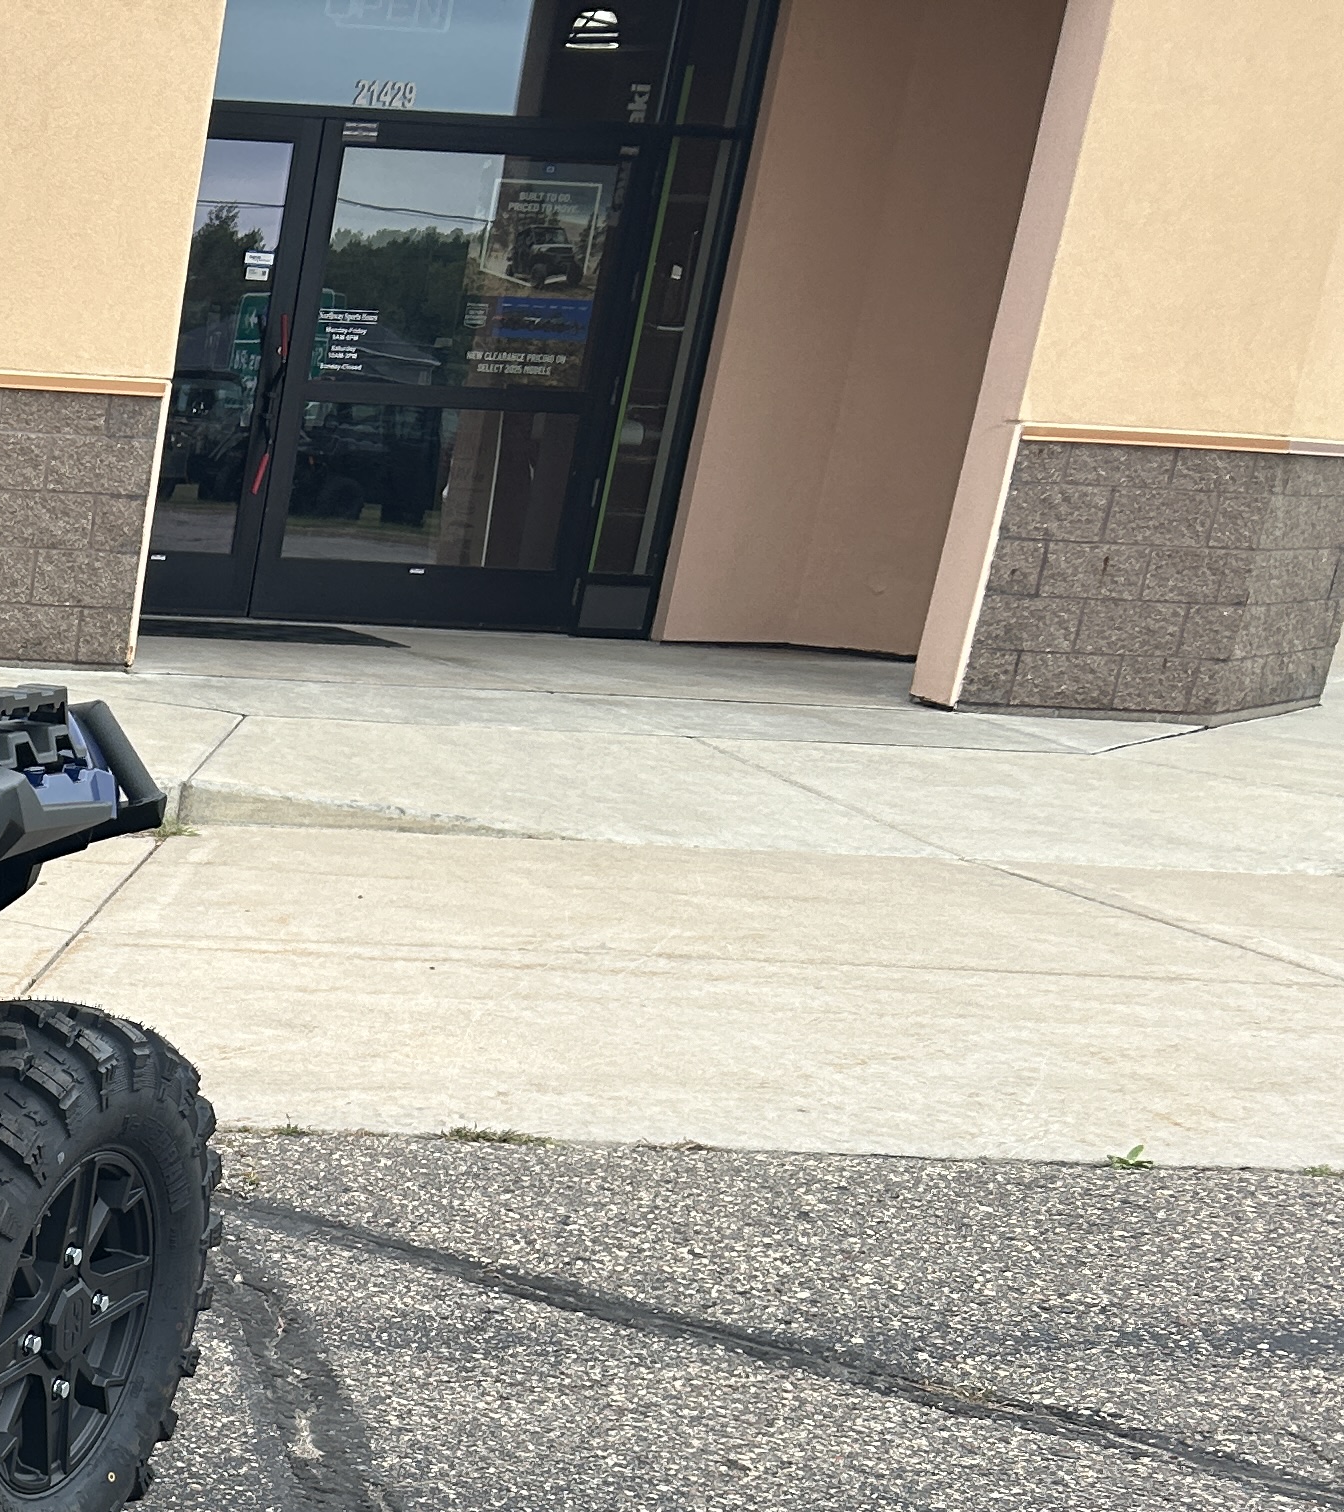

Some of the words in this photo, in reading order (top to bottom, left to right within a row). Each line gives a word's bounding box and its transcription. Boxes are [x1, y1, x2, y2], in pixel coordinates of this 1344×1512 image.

[353, 79, 417, 108] 21429
[519, 191, 544, 202] BUILT
[547, 193, 556, 202] TO
[508, 202, 540, 212] PRICED
[541, 203, 552, 212] TO
[466, 351, 484, 360] NEW
[484, 352, 525, 362] CLEARANCE
[477, 363, 504, 373] SELECT
[523, 365, 552, 376] MODELS
